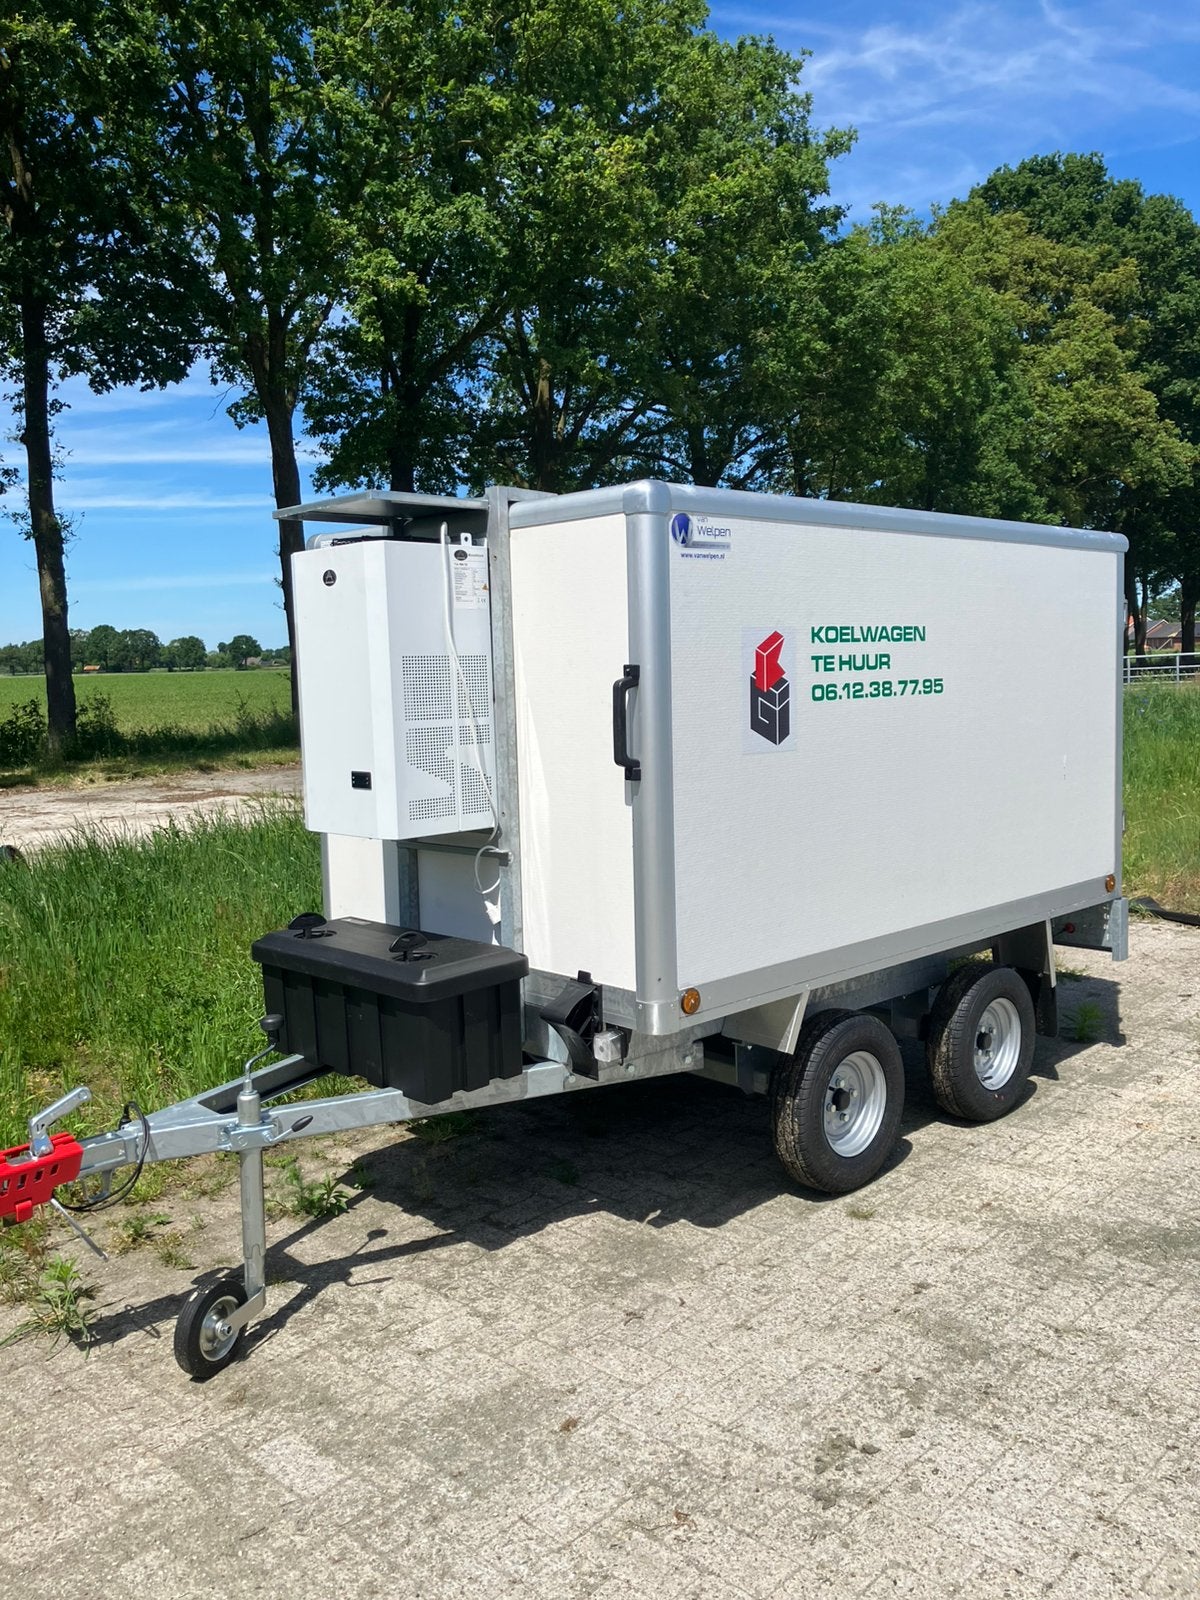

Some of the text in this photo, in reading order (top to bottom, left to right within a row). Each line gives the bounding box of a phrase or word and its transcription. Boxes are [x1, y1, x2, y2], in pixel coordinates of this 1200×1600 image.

[811, 626, 926, 643] KOELWAGEN
[811, 654, 891, 672] TE HUUR
[811, 678, 944, 701] 06.12.38.77.95
